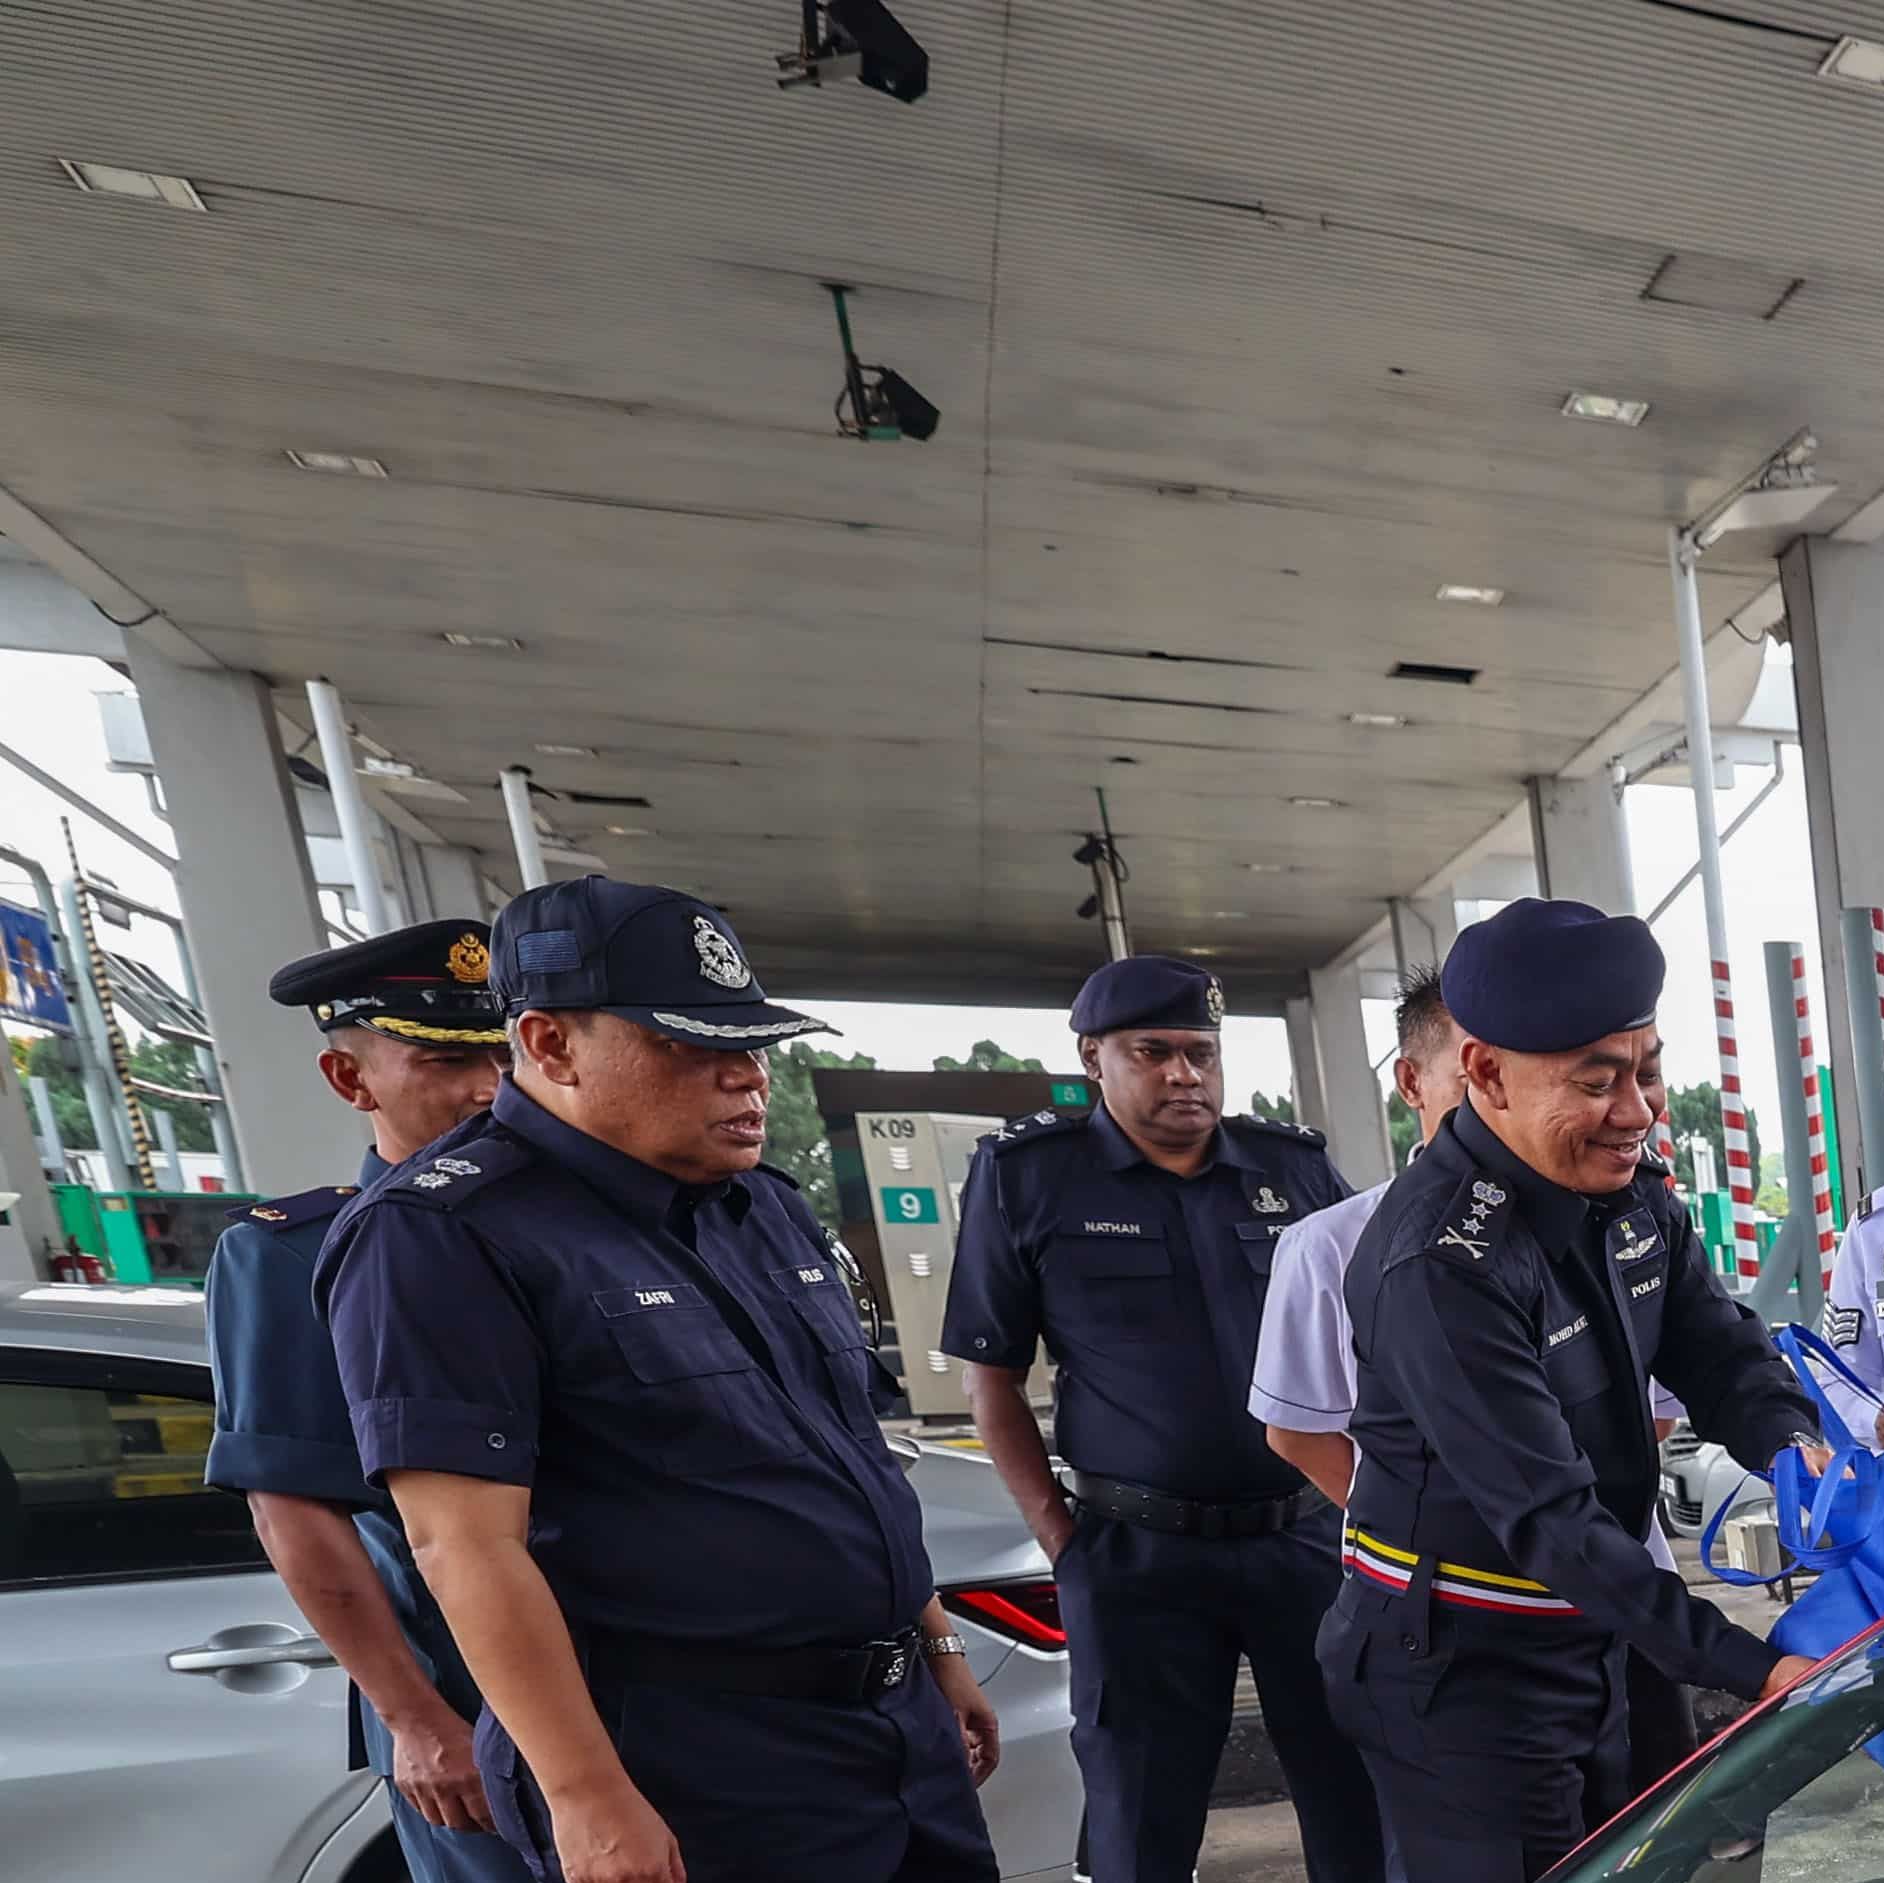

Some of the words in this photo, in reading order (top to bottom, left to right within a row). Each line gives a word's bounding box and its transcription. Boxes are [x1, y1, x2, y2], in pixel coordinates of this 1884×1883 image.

[899, 1192, 921, 1219] 9
[1084, 1221, 1141, 1234] NATHAN
[1631, 1277, 1661, 1298] POLIS
[635, 1291, 675, 1306] ZAFRI
[1548, 1326, 1573, 1346] MOHD
